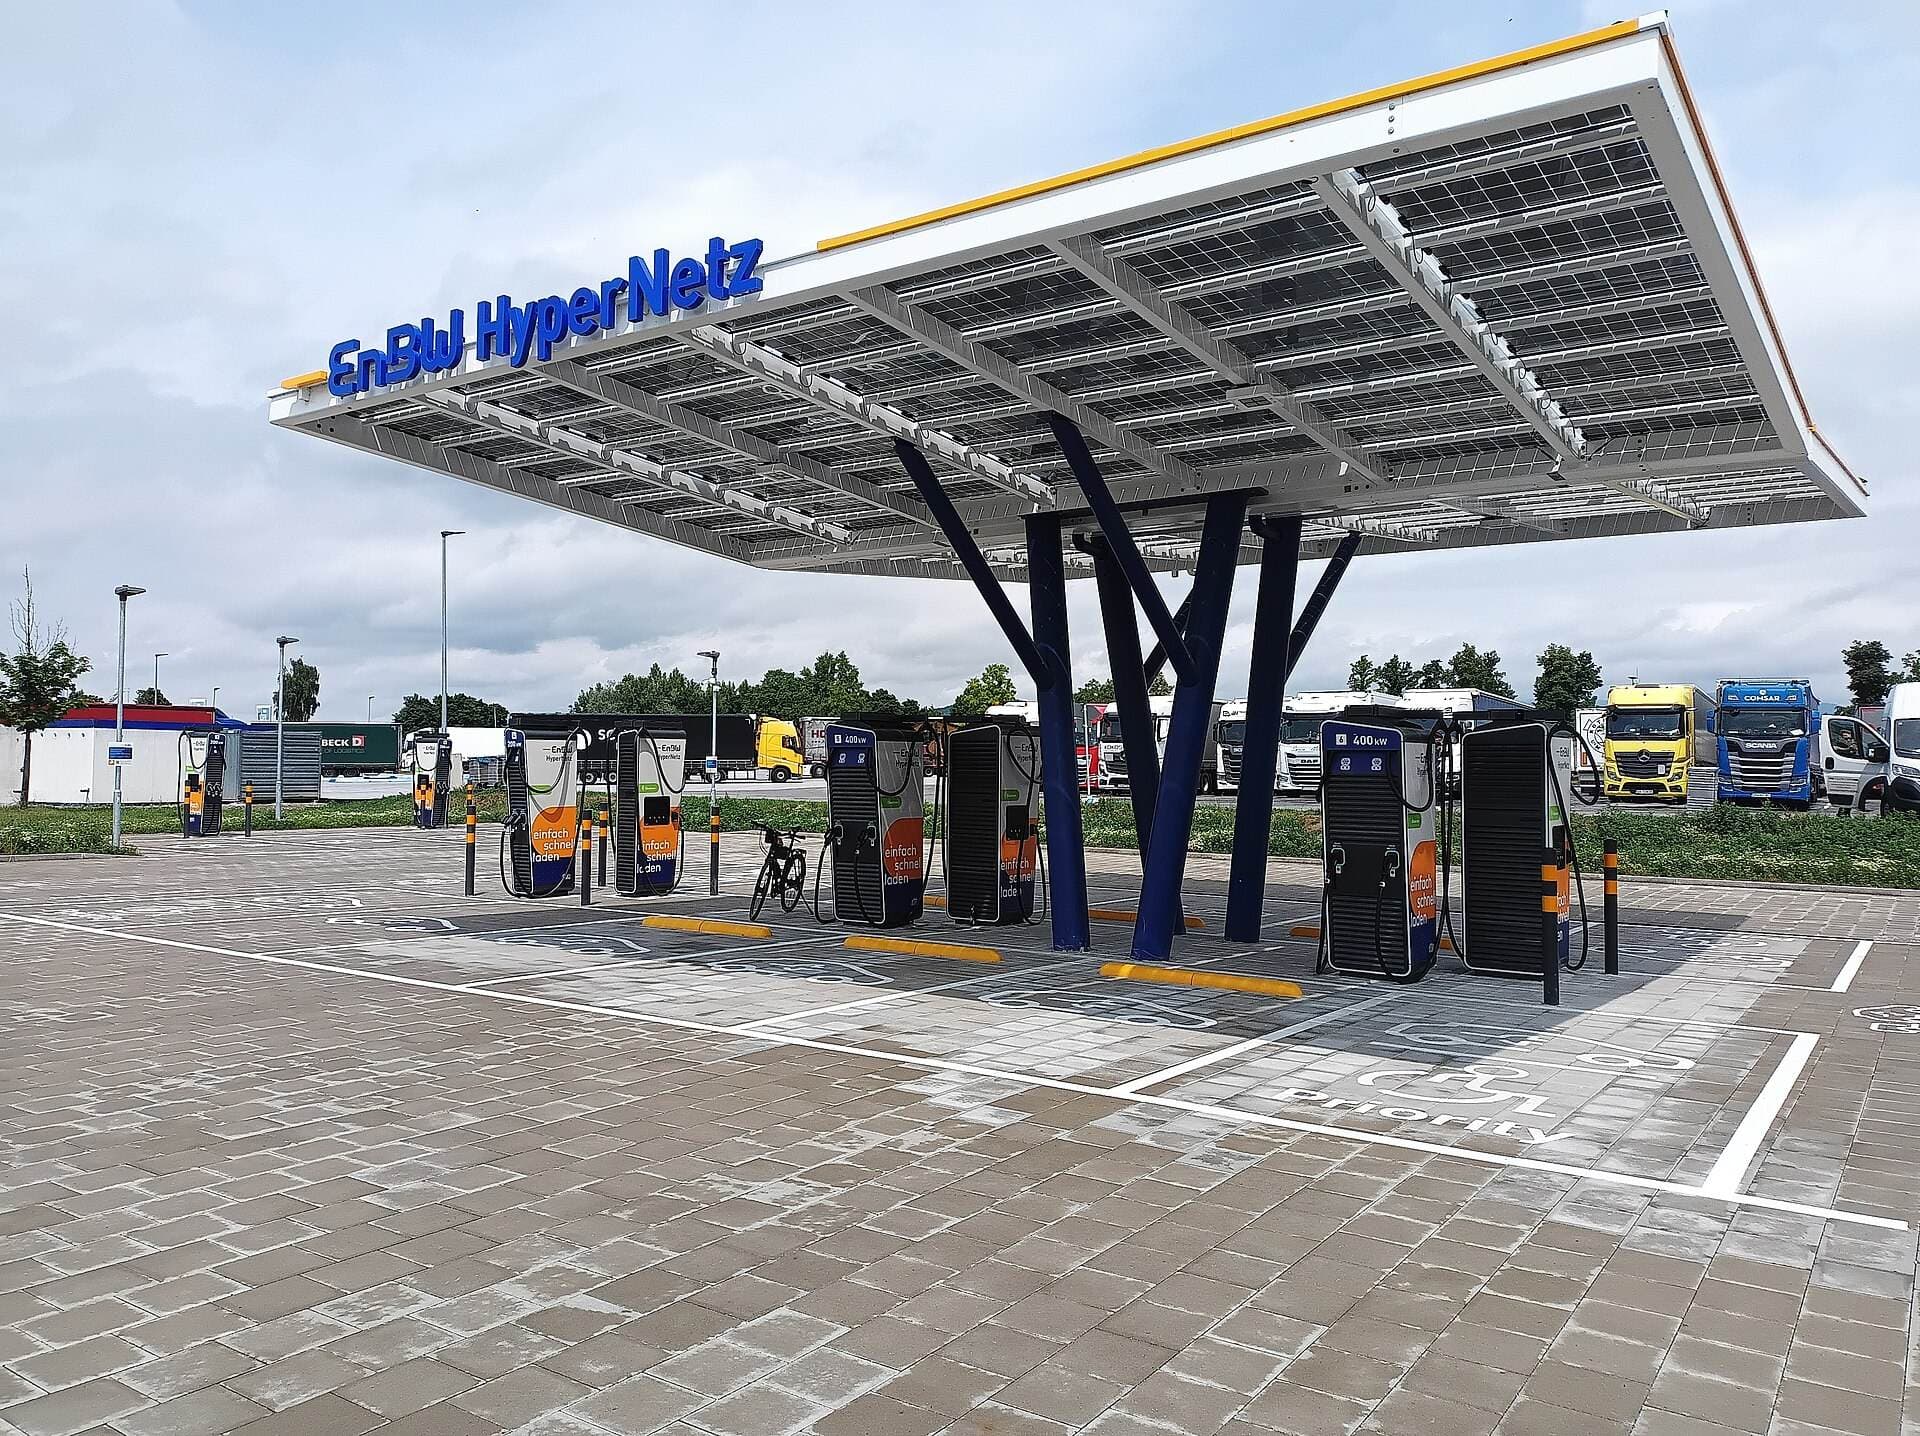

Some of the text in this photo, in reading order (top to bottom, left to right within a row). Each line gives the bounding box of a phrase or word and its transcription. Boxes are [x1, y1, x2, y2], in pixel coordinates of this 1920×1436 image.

[327, 236, 765, 398] EnBW HyperNetz
[1353, 735, 1373, 746] 400
[533, 827, 569, 840] einfach
[532, 851, 560, 862] laden
[884, 843, 917, 858] einfach
[884, 873, 909, 886] laden
[1273, 1086, 1577, 1145] Priority
